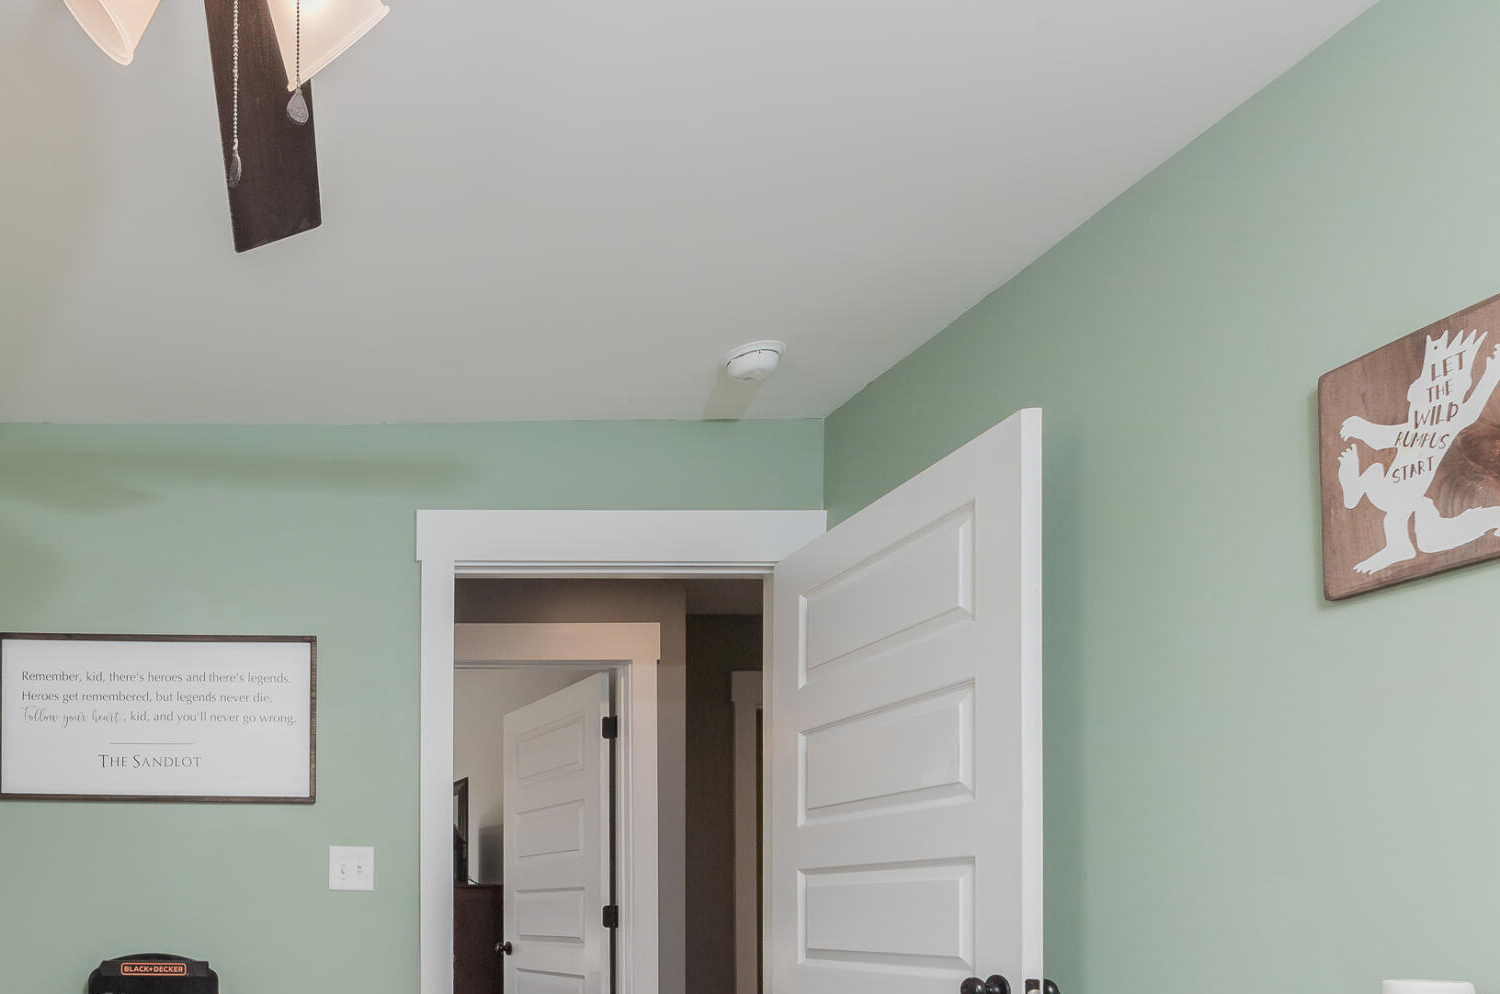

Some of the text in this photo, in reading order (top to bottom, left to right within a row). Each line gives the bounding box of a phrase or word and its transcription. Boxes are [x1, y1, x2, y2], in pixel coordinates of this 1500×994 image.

[1430, 349, 1467, 382] LET
[1426, 378, 1453, 403] THE
[1414, 402, 1459, 429] WILD
[1394, 430, 1450, 450] RUMPUS
[1392, 455, 1434, 484] START
[21, 671, 292, 686] Remember, kid, there's heroes and there's legends.
[21, 690, 273, 705] Heroes get remembered, but legends never die.
[21, 705, 58, 721] Follow
[61, 711, 86, 728] your
[130, 711, 150, 722] kid,
[153, 711, 174, 722] and
[177, 711, 207, 724] you'll
[210, 714, 239, 723] never
[242, 715, 257, 726] go
[259, 715, 297, 726] wrong.
[98, 754, 128, 768] THE
